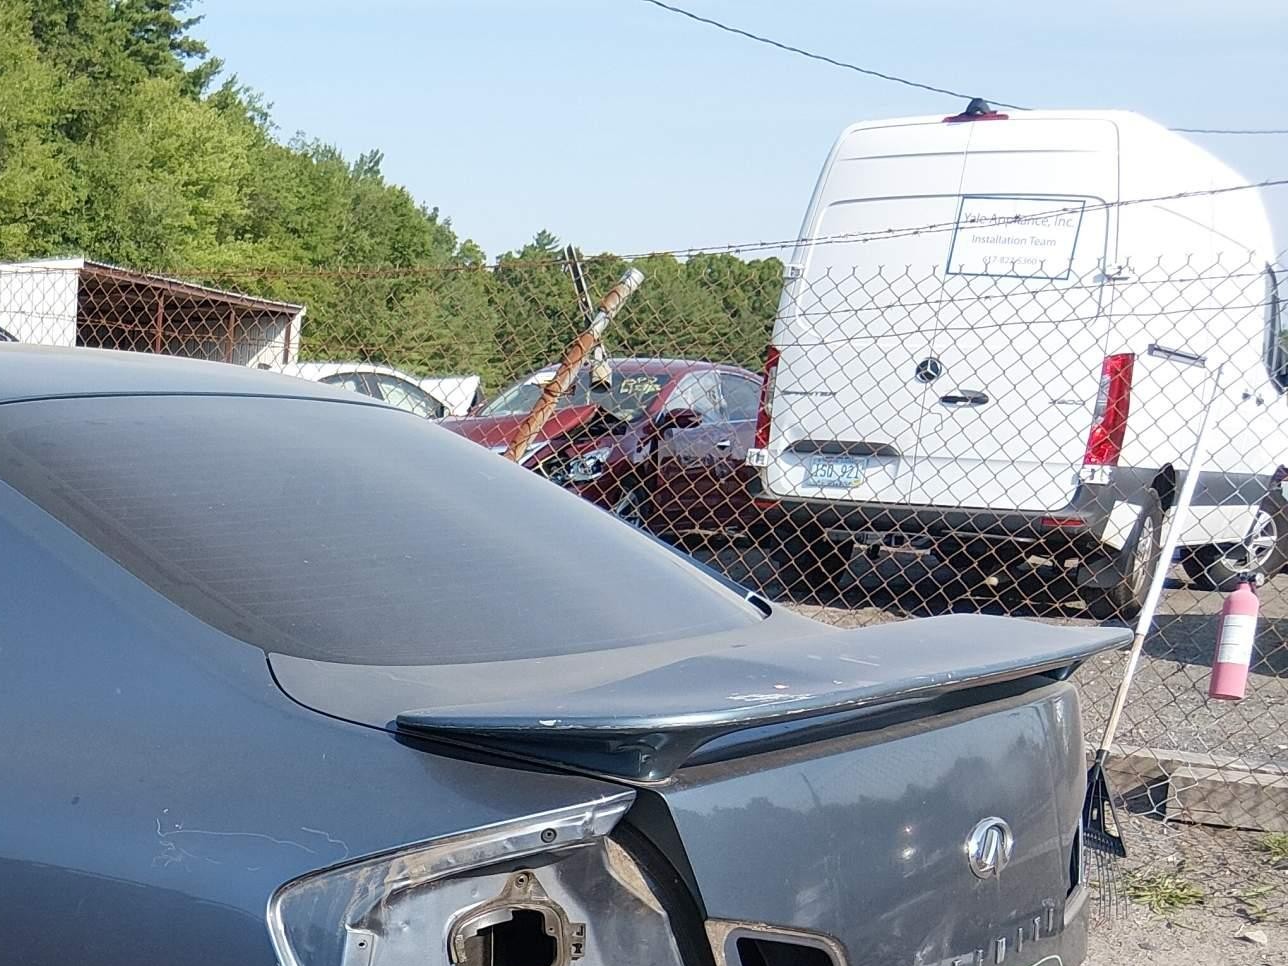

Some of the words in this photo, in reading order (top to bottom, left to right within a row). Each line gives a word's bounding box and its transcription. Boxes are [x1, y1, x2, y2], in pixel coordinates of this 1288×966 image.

[1054, 214, 1075, 228] Inc.
[972, 234, 1027, 245] Installation
[1029, 235, 1057, 247] Team
